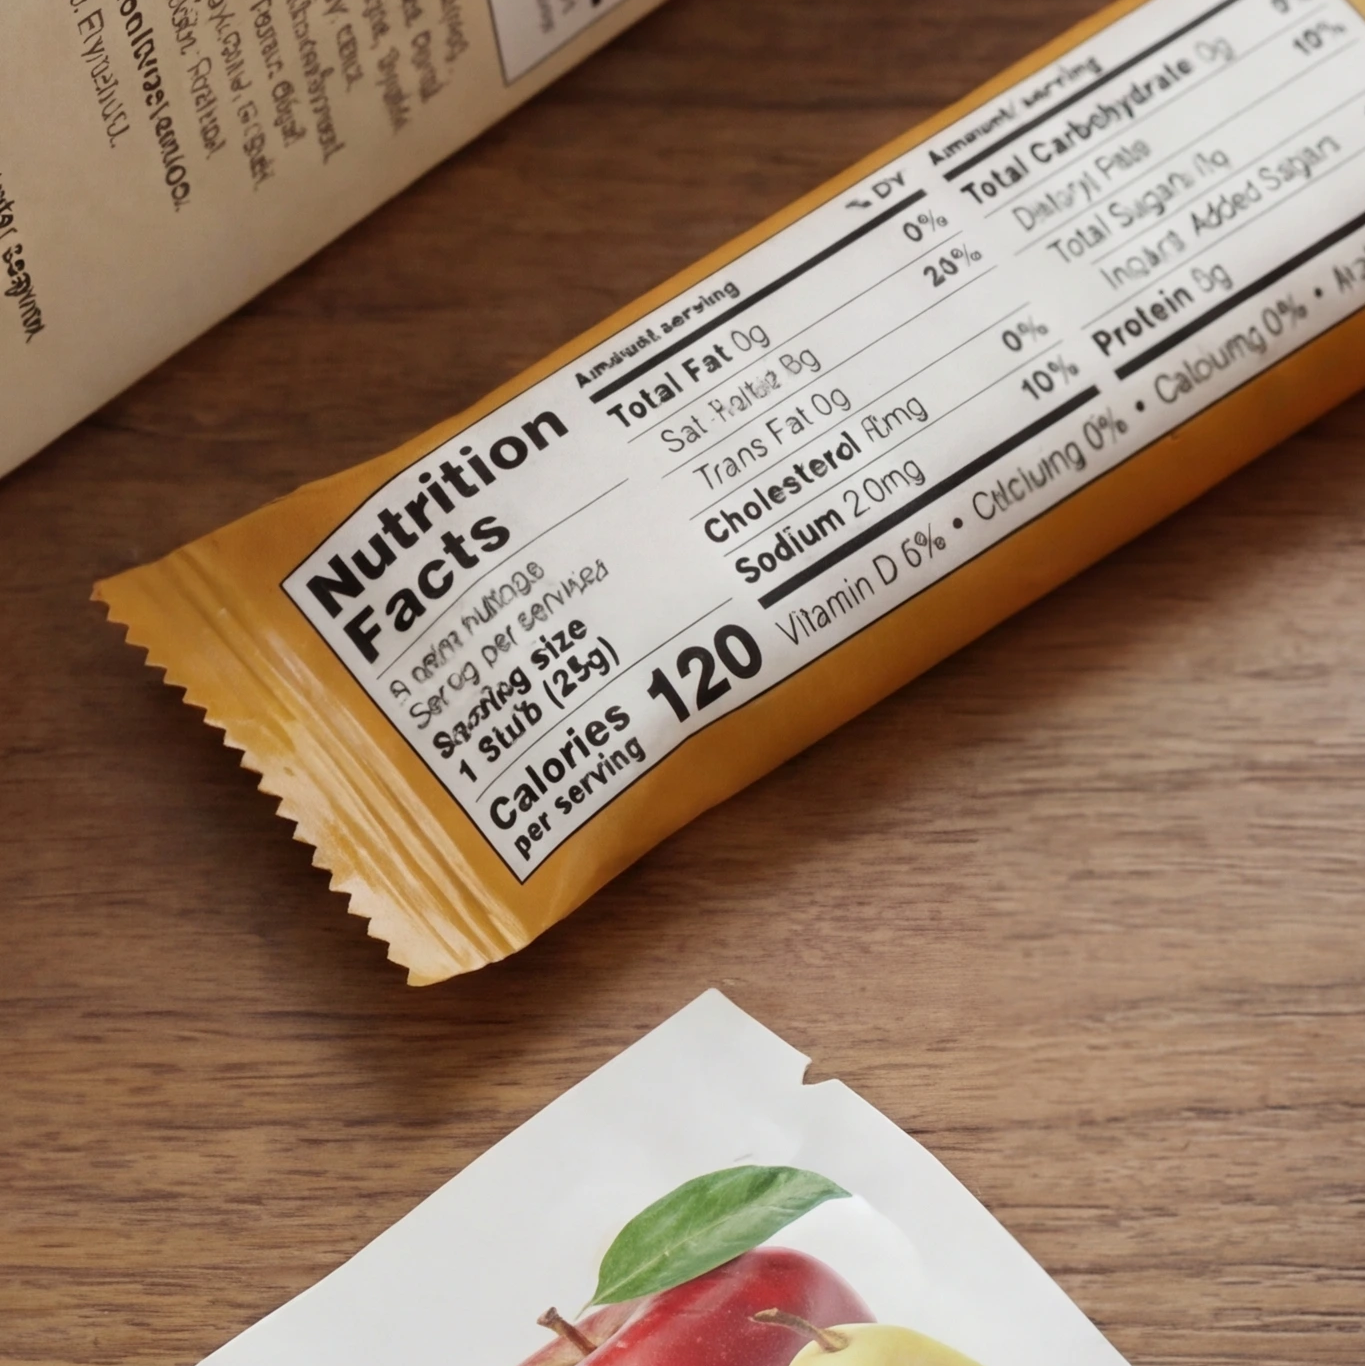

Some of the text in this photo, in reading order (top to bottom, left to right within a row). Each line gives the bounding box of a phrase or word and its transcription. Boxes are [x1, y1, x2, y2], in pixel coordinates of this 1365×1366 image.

[958, 153, 1031, 206] Total
[1090, 286, 1195, 358] Protein
[605, 343, 734, 429] Total Fat
[764, 406, 815, 446] Fat
[304, 410, 570, 620] Nutrition
[703, 429, 863, 544] Cholesterol
[734, 357, 1081, 585] Sodium 10%
[341, 514, 512, 666] Facts
[774, 576, 876, 647] Vitamin
[529, 618, 588, 672] size
[488, 704, 631, 831] Calories
[645, 623, 764, 724] 120
[513, 735, 647, 863] per serving
